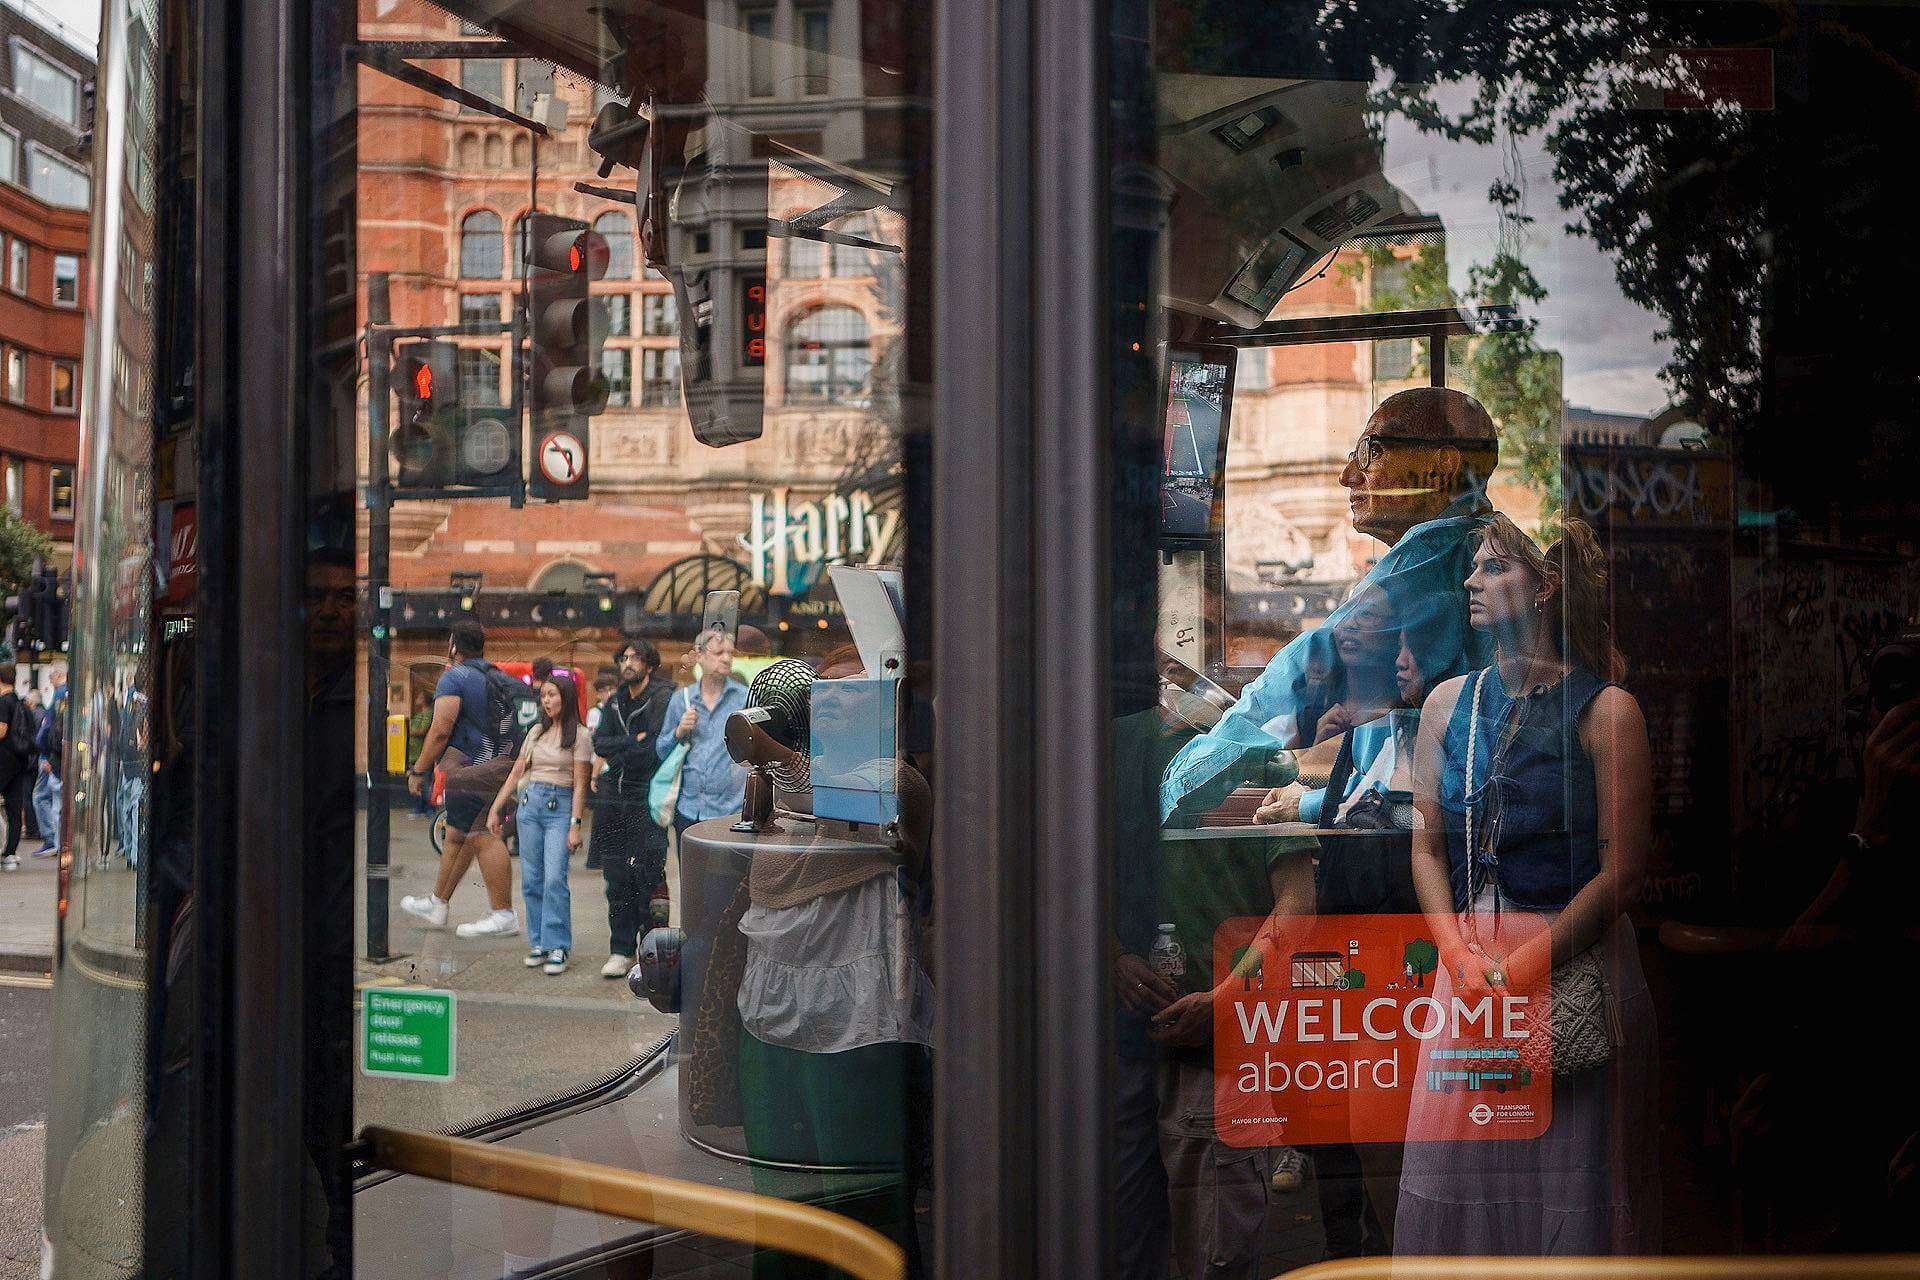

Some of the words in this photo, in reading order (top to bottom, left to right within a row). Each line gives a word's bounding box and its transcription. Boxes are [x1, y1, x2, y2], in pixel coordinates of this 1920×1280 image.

[738, 485, 901, 596] Harry
[1233, 996, 1530, 1044] WELCOME
[1237, 1048, 1399, 1093] aboard
